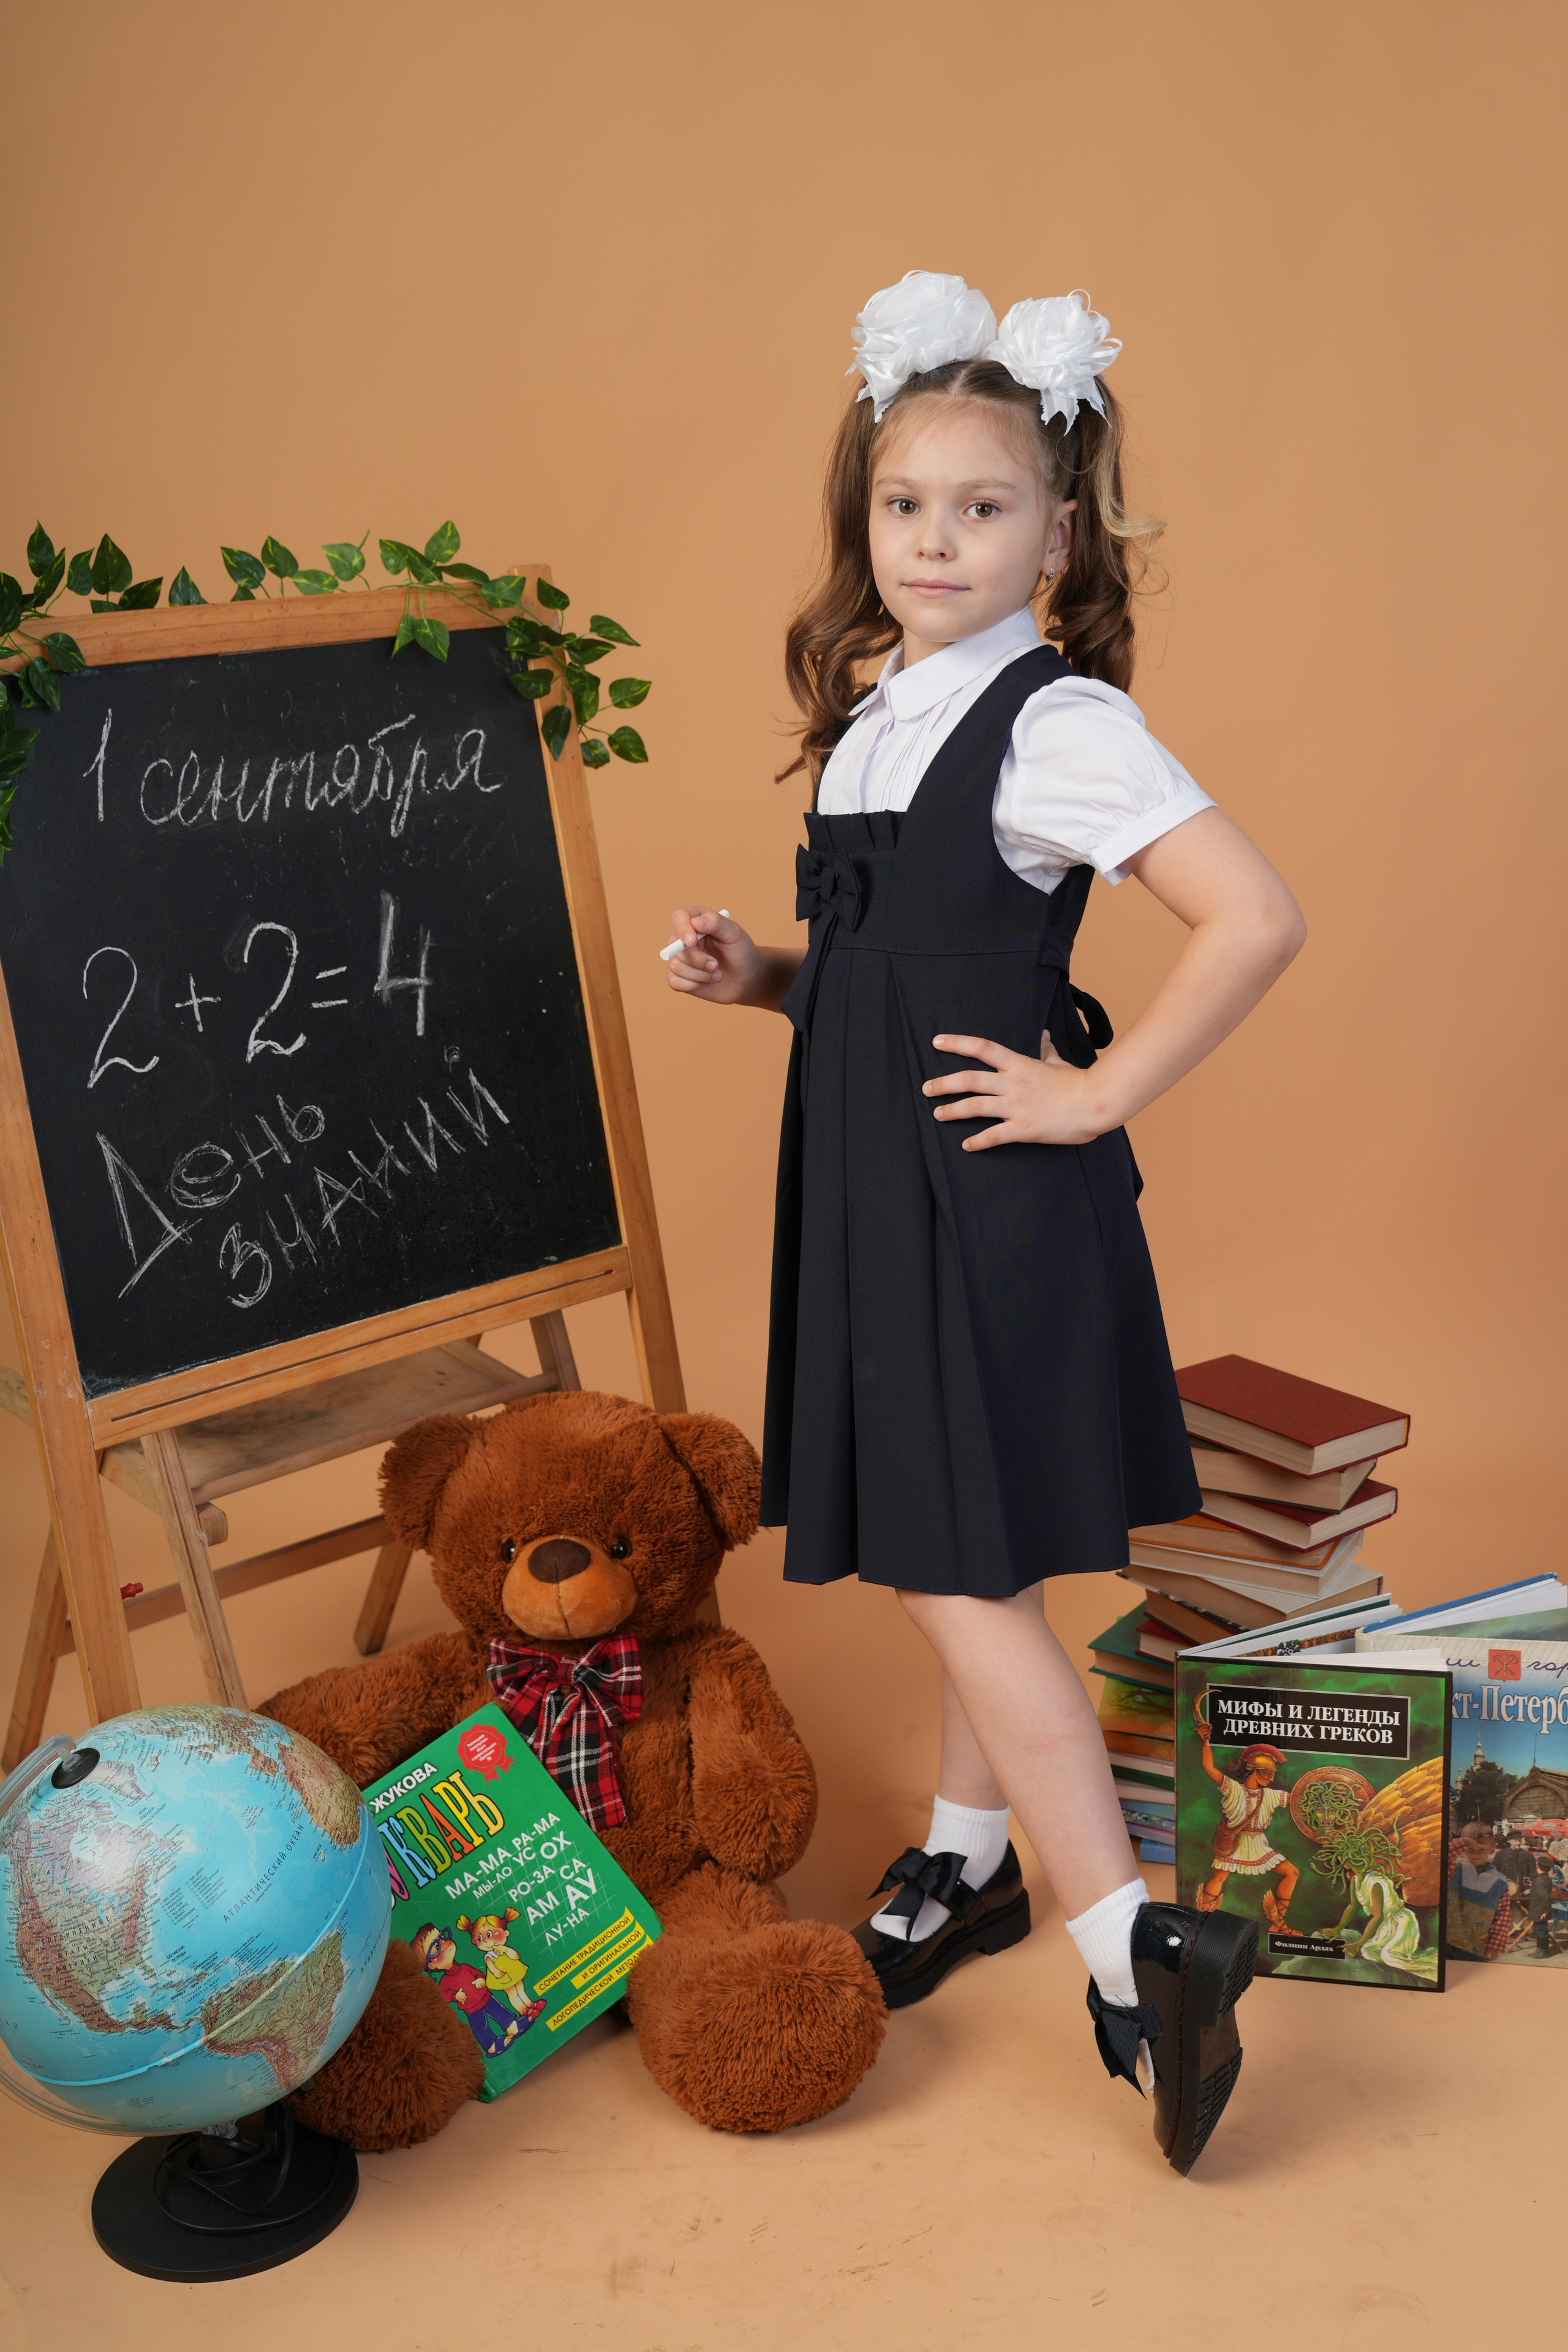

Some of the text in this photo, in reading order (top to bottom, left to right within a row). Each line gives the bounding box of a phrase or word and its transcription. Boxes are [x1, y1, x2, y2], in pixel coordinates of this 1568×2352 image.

[83, 708, 503, 837] 1 сентября
[1218, 1699, 1400, 1727] МИФЫ И ЛЕГЕНДЫ
[1223, 1718, 1393, 1744] ДРЕВНИХ ГРЕКОВ
[1452, 1684, 1568, 1734] кт-Петерб
[369, 1762, 438, 1814] ЖУКОВА
[223, 1852, 287, 1922] АТЛАНТИЧЕСКИЙ
[286, 1824, 304, 1850] ОКЕАН
[445, 1812, 560, 1899] МА-МА РА-МА
[472, 1830, 572, 1899] МЫ-ЛО УС ОХ
[508, 1858, 587, 1902] РО-ЗА СА
[526, 1868, 597, 1926] АМ АУ
[538, 1916, 631, 1991] СОЧЕТАНИЕ ТРАДИЦИОННОЙ
[589, 1930, 641, 1975] ОРИГИНАЛЬНОЙ
[209, 1979, 221, 1988] МОРЕ
[552, 1973, 614, 2026] ЛОГОПЕДИЧЕСКОЙ
